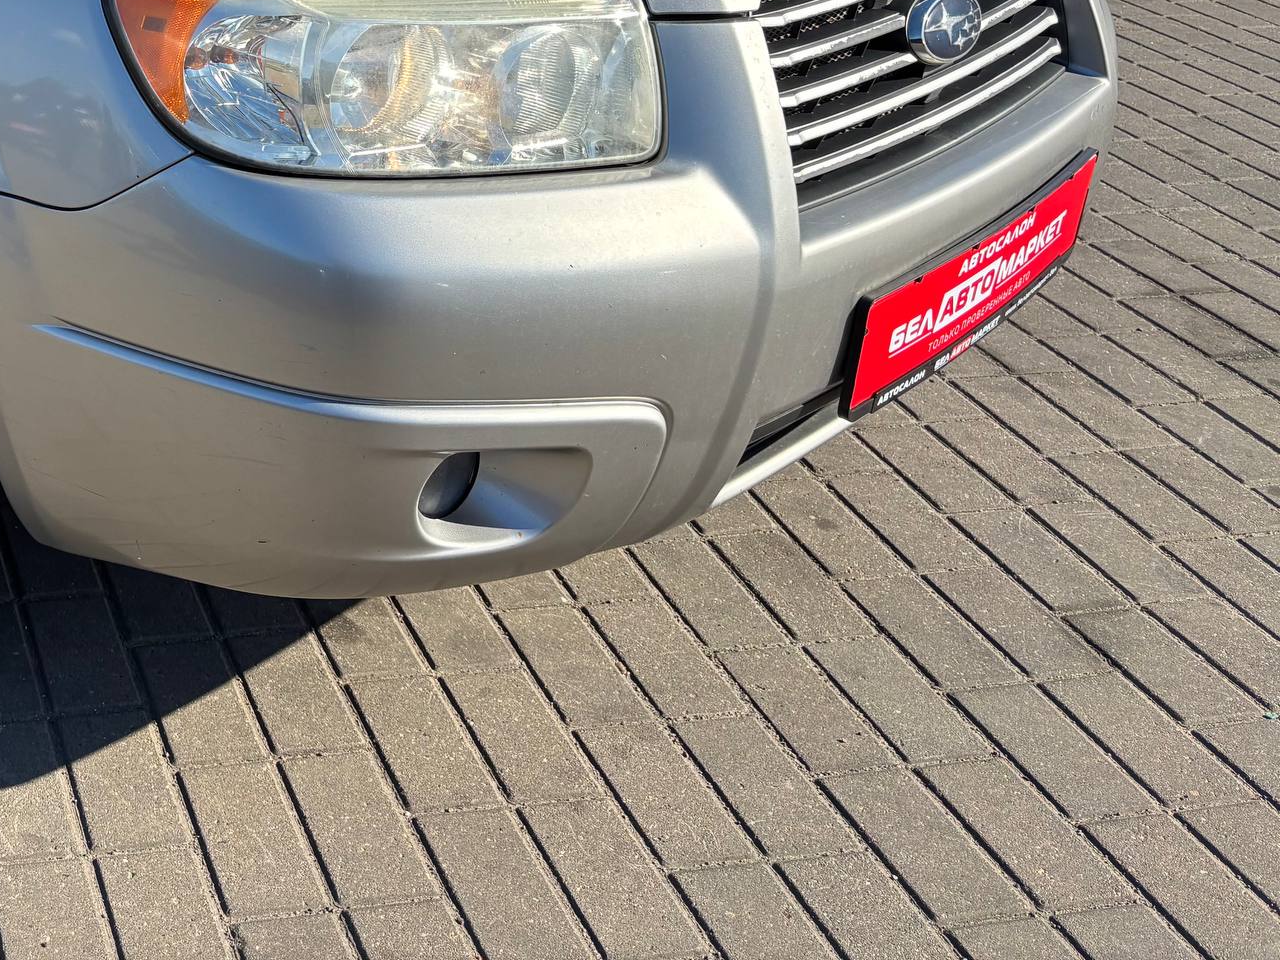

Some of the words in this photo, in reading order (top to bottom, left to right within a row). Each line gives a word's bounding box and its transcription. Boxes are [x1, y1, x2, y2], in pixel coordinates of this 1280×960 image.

[958, 212, 1037, 277] АВТОСАЛОН
[927, 324, 960, 353] ТОЛЬКО
[876, 369, 926, 406] АВТОСАЛОН
